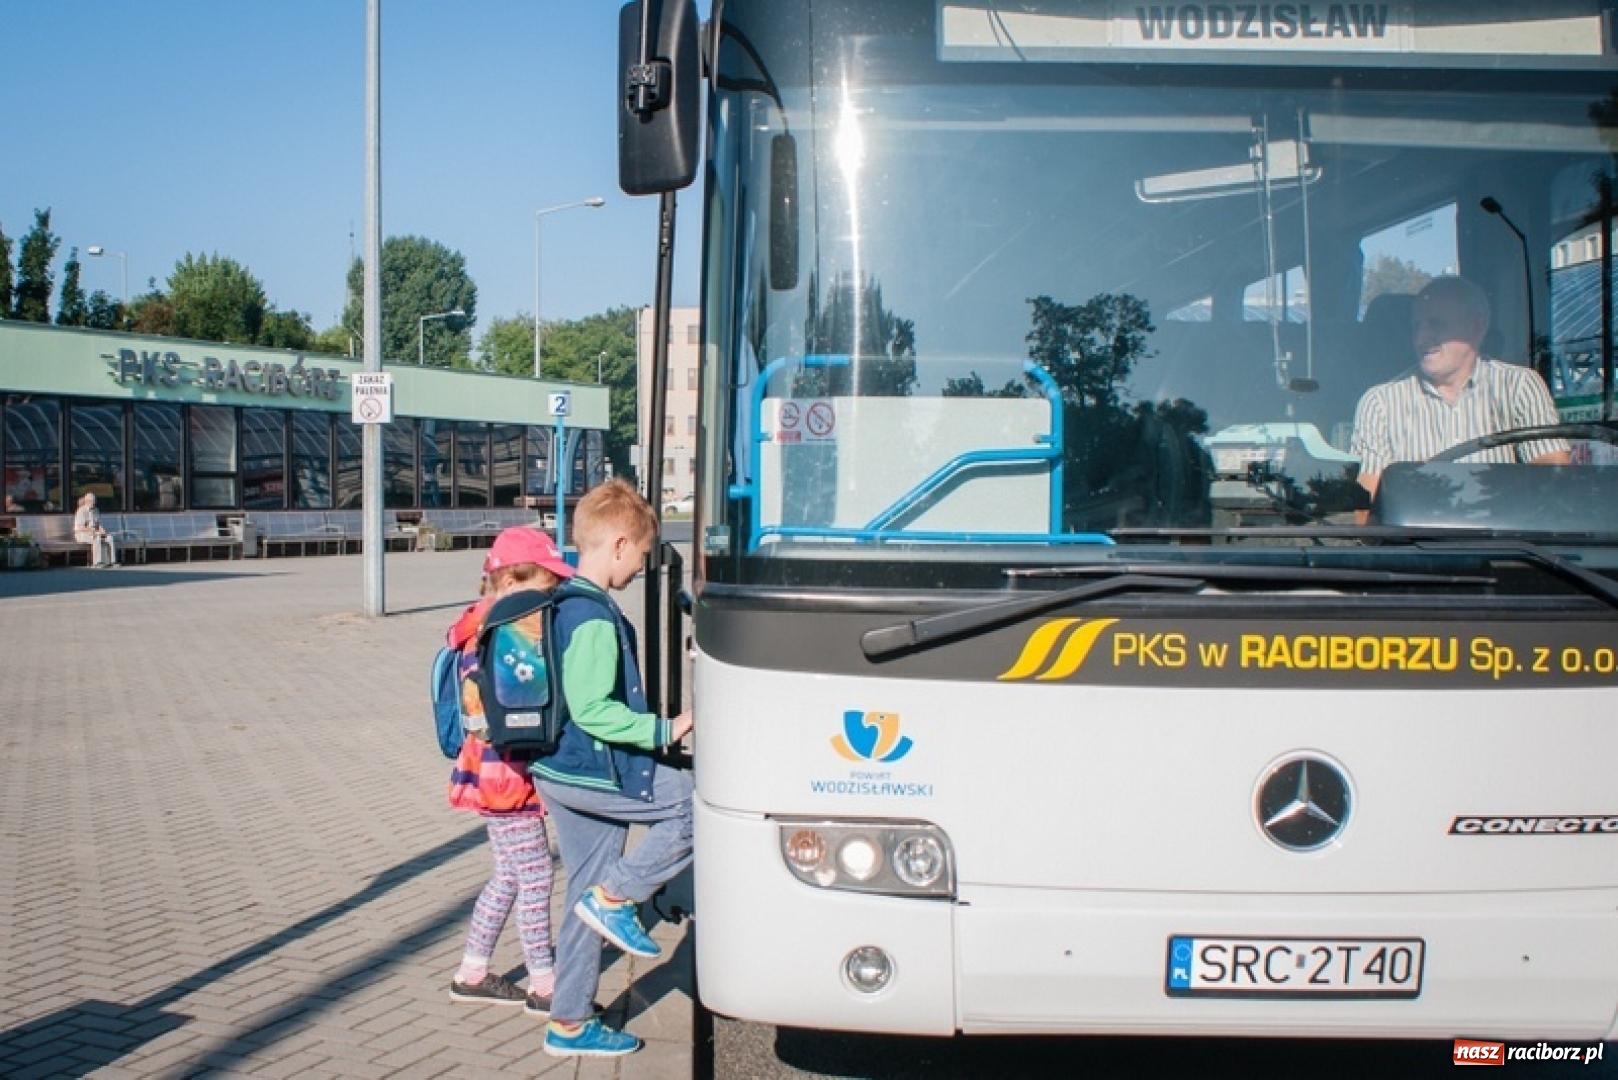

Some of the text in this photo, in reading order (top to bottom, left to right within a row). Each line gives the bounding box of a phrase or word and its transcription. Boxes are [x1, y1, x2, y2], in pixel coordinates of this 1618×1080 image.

[1135, 3, 1388, 40] WODZISŁAW
[119, 348, 342, 399] PKS RACIBÓRZ
[357, 375, 385, 385] ZAKAZ
[554, 396, 566, 413] 2
[1113, 632, 1187, 668] PKS
[1198, 642, 1229, 668] w
[1240, 634, 1459, 670] RACIBORZU
[1469, 637, 1523, 680] Sp.
[1532, 646, 1550, 672] z
[810, 780, 933, 796] WODZISŁAWSKI
[1455, 817, 1618, 832] CONECTO
[1200, 944, 1412, 984] SRC 2T40
